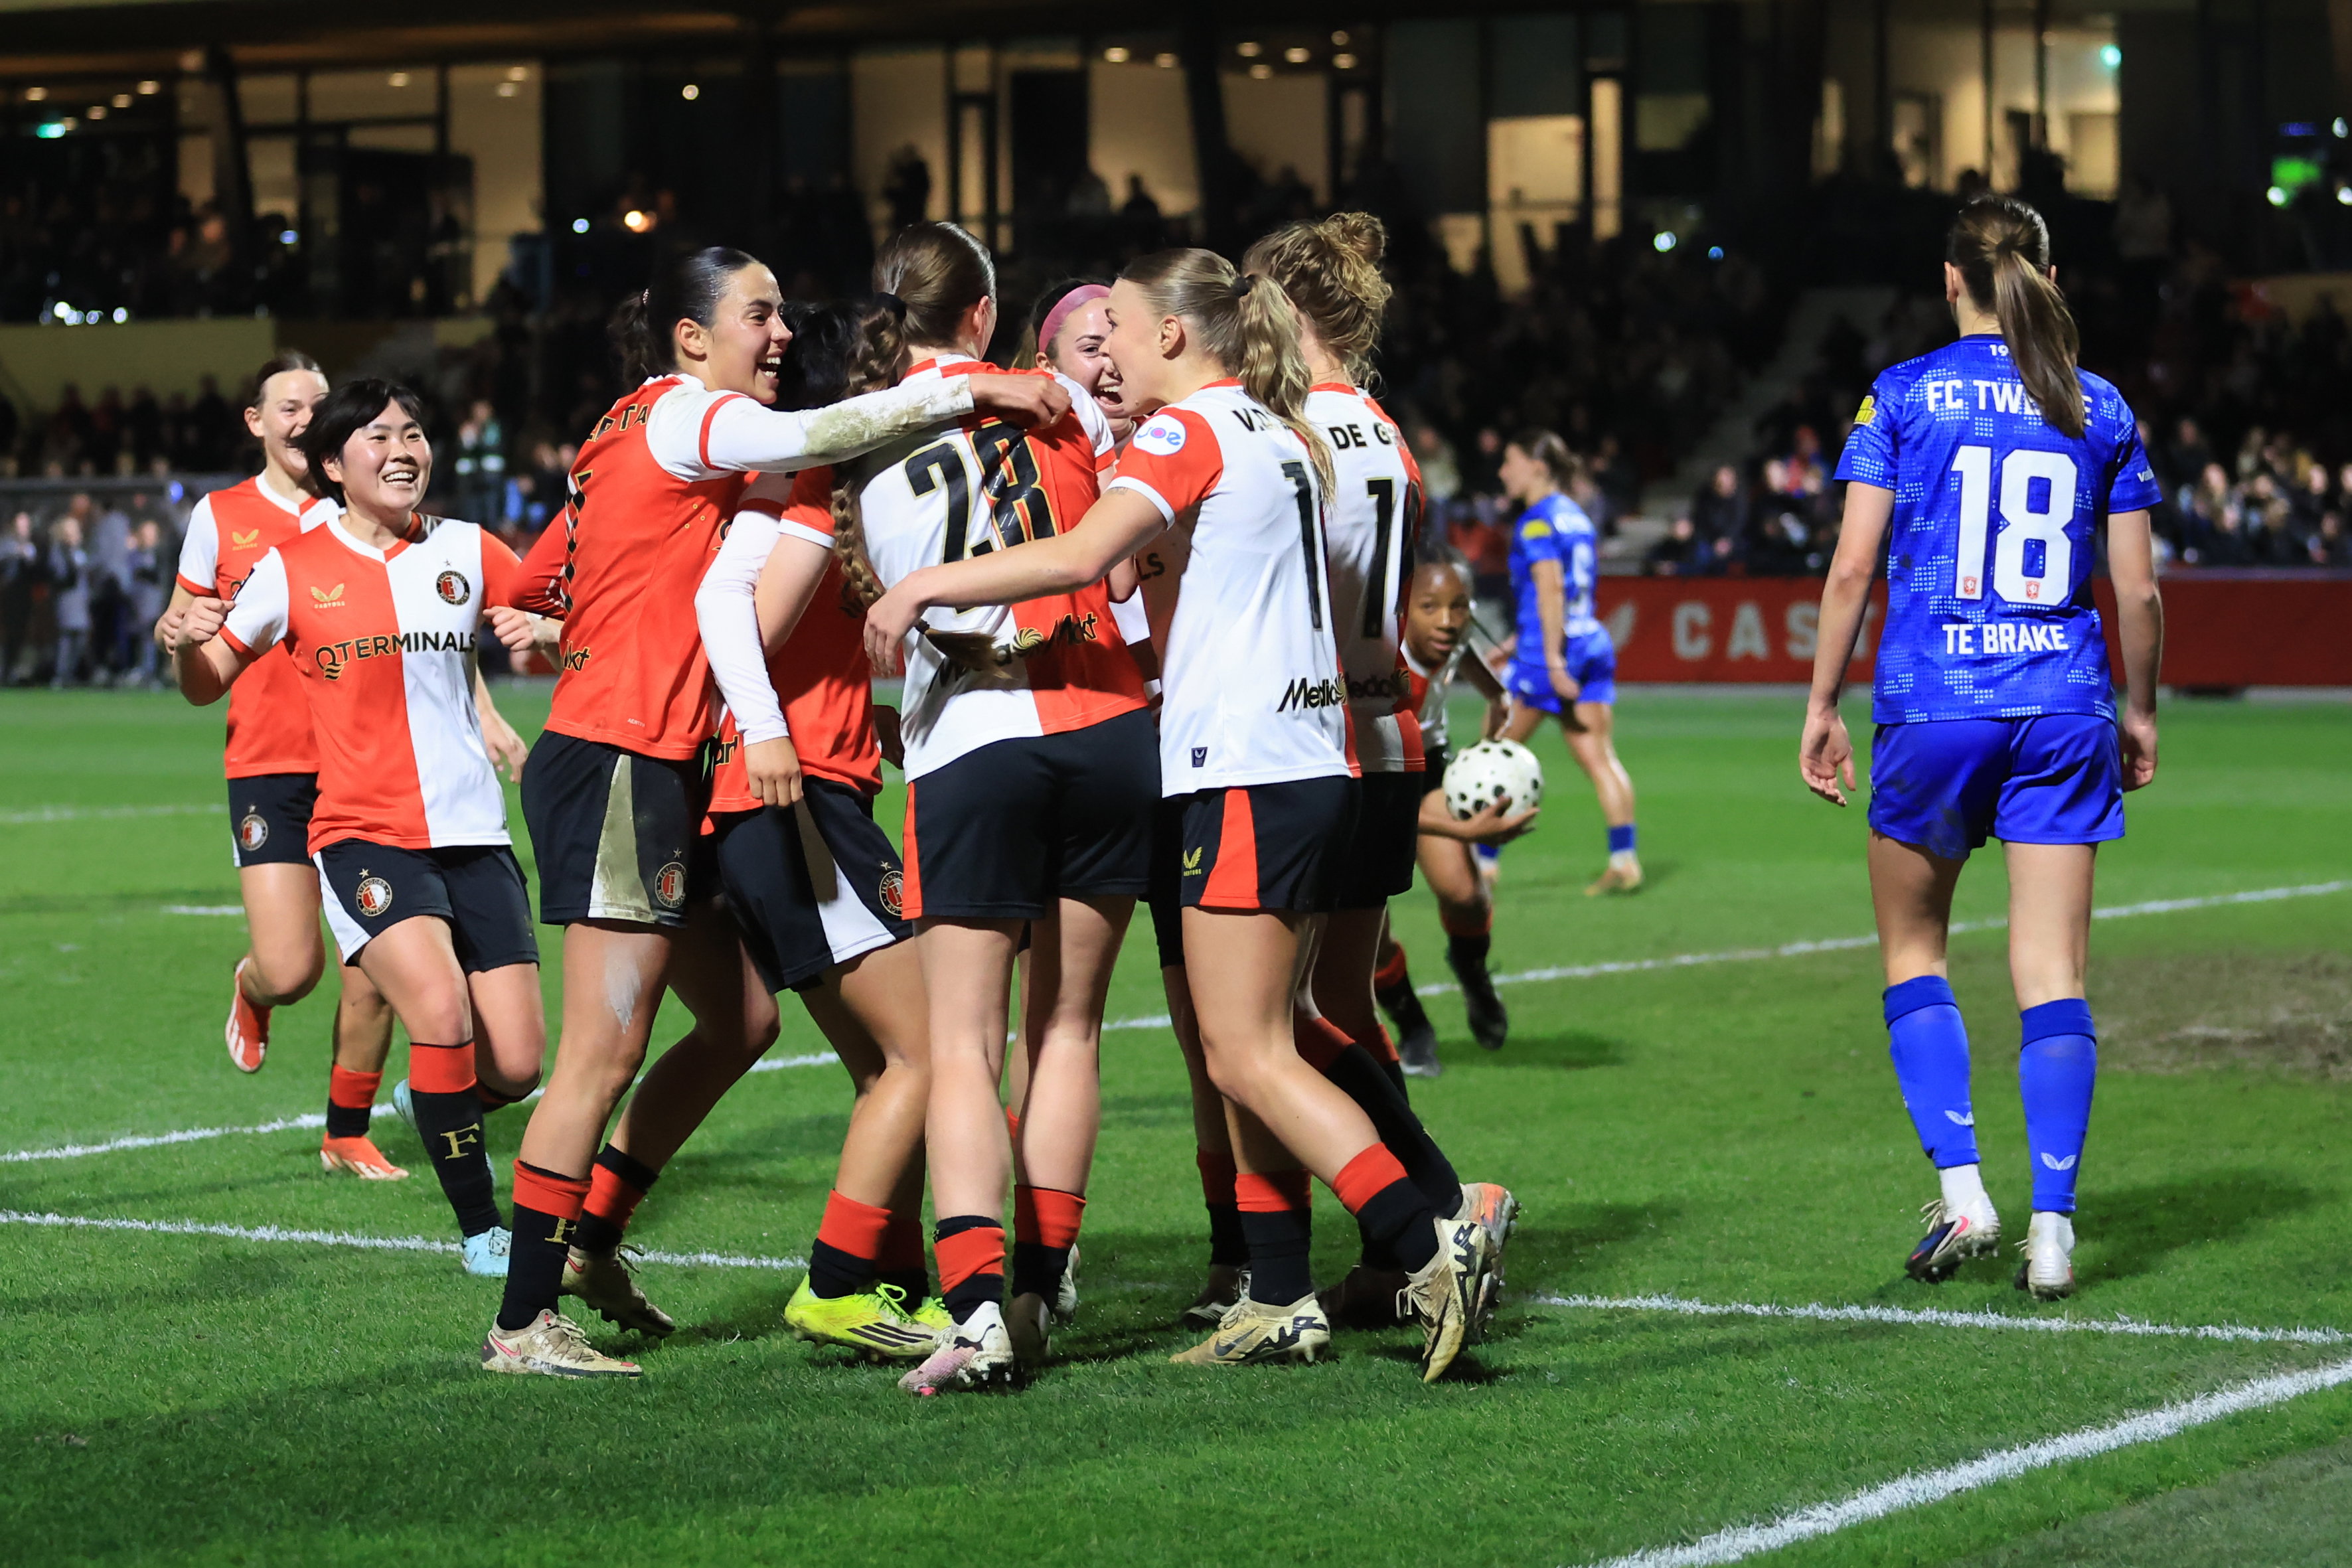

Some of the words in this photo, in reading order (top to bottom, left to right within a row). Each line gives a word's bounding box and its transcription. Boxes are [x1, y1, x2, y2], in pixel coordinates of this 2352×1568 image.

[1926, 379, 1963, 413] FC
[1972, 379, 2092, 427] TWEE
[1328, 423, 1368, 449] DE
[903, 420, 1058, 616] 28
[1950, 445, 2078, 607] 18
[315, 631, 476, 680] QTERMINALS
[1942, 623, 1974, 655] TE
[1982, 623, 2069, 654] BRAKE
[440, 1123, 480, 1160] F
